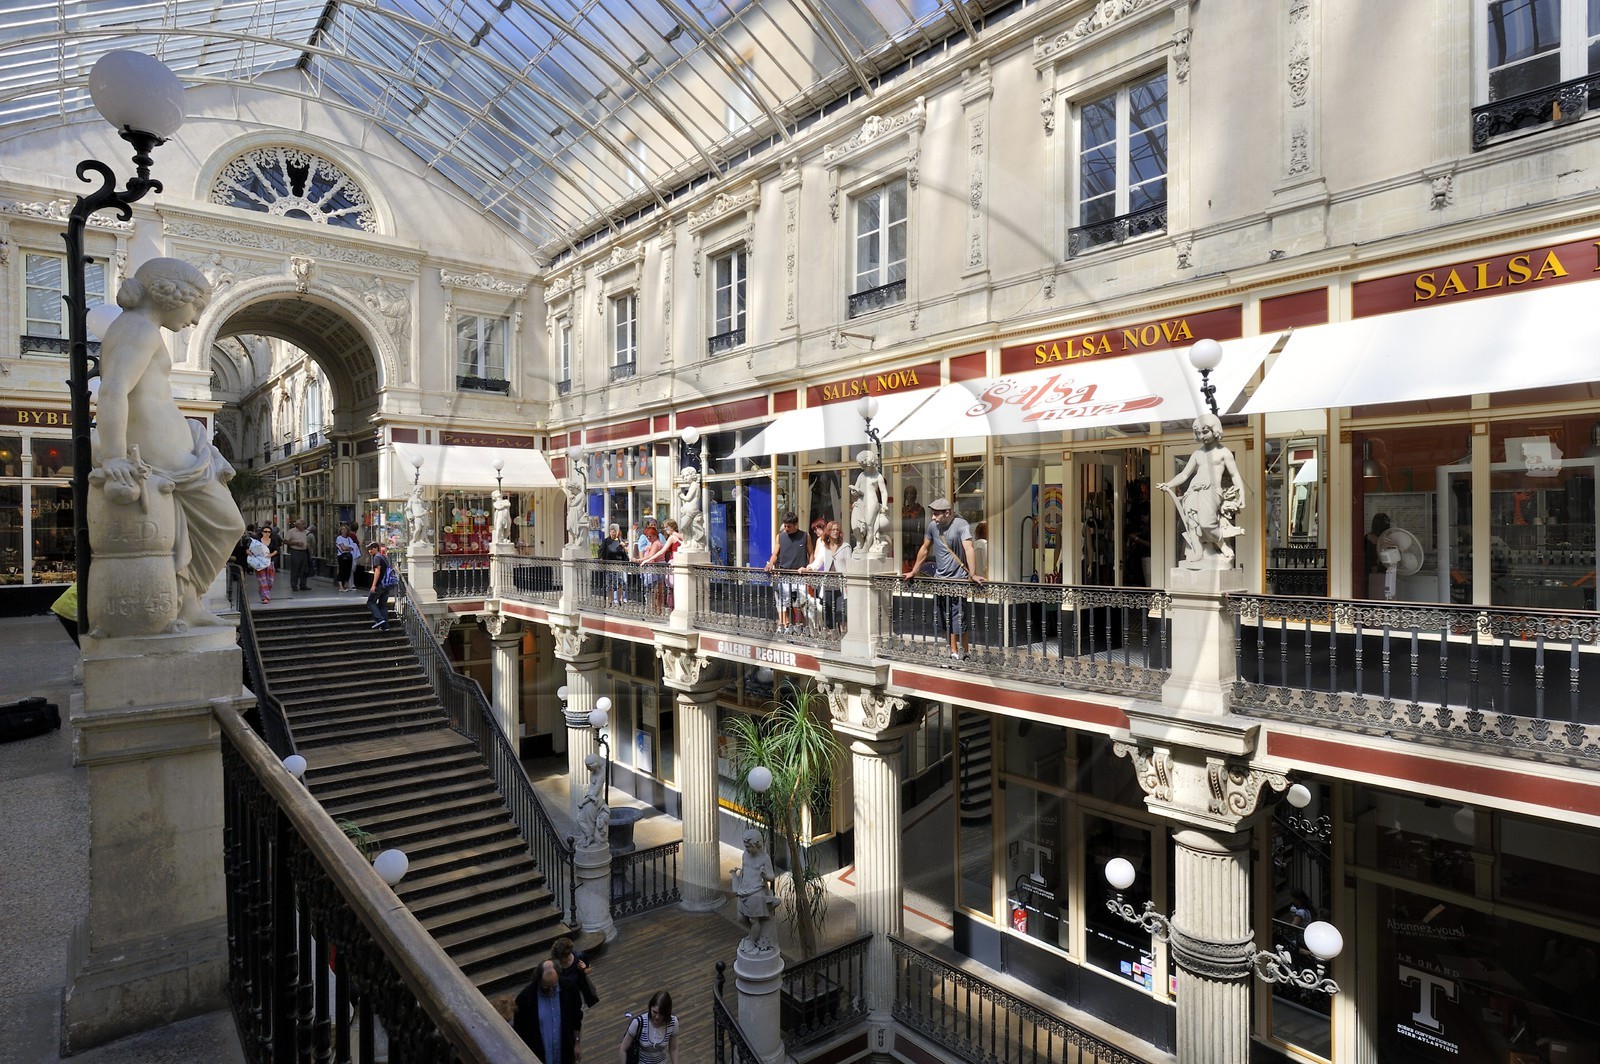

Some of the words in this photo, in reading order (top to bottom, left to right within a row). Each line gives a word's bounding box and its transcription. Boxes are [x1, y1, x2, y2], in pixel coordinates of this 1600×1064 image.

[1414, 250, 1570, 302] SALSA
[1034, 334, 1113, 365] SALSA
[1121, 319, 1194, 350] NOVA
[823, 379, 870, 401] SALSA
[876, 369, 919, 392] NOVA
[965, 373, 1098, 418] Salsa
[717, 640, 752, 658] GALERIE
[755, 646, 797, 667] REGNIER
[1386, 917, 1466, 937] Abonnez-vous!
[1397, 952, 1412, 963] LE
[1417, 959, 1460, 977] GRAND
[1398, 964, 1458, 1033] T
